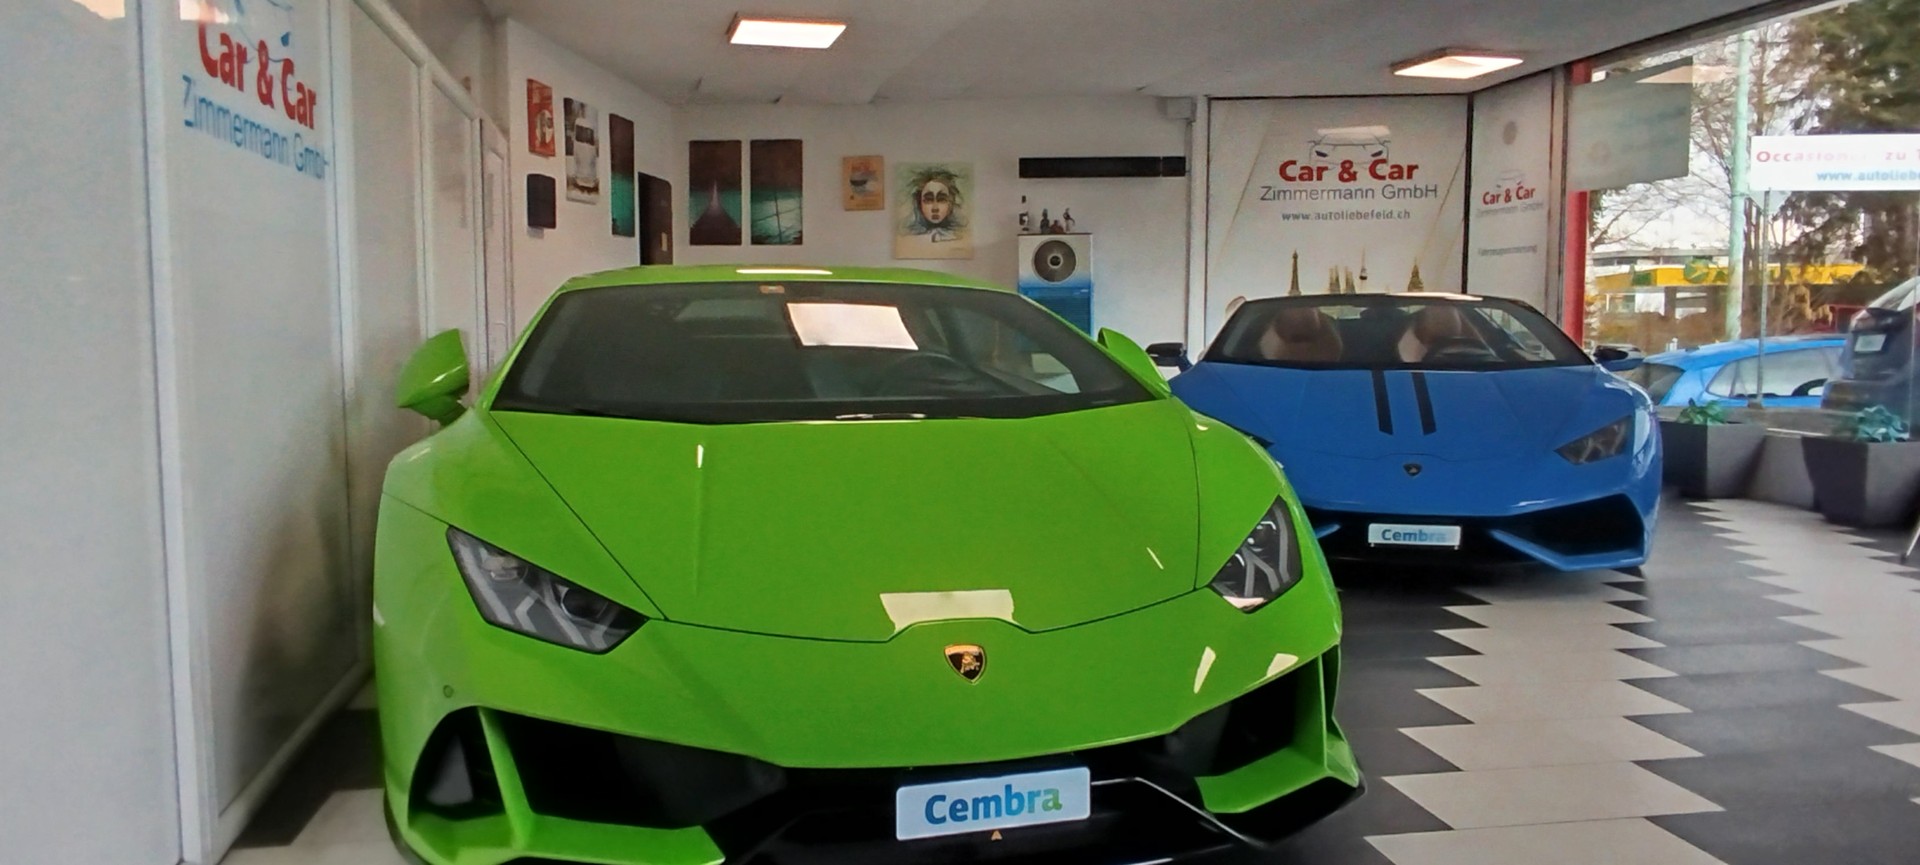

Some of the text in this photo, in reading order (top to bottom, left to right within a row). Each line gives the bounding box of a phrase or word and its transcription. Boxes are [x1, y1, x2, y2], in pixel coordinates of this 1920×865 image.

[197, 22, 317, 130] Car & Car
[182, 74, 291, 166] Zimmermann
[1756, 151, 1866, 163] Occasion
[1278, 158, 1420, 182] Car & Car
[1259, 183, 1439, 201] Zimmermann GmbH
[1482, 186, 1536, 205] Car & Car
[1281, 209, 1412, 222] www.autoliebefeld.ch
[924, 784, 1063, 825] Cembra
